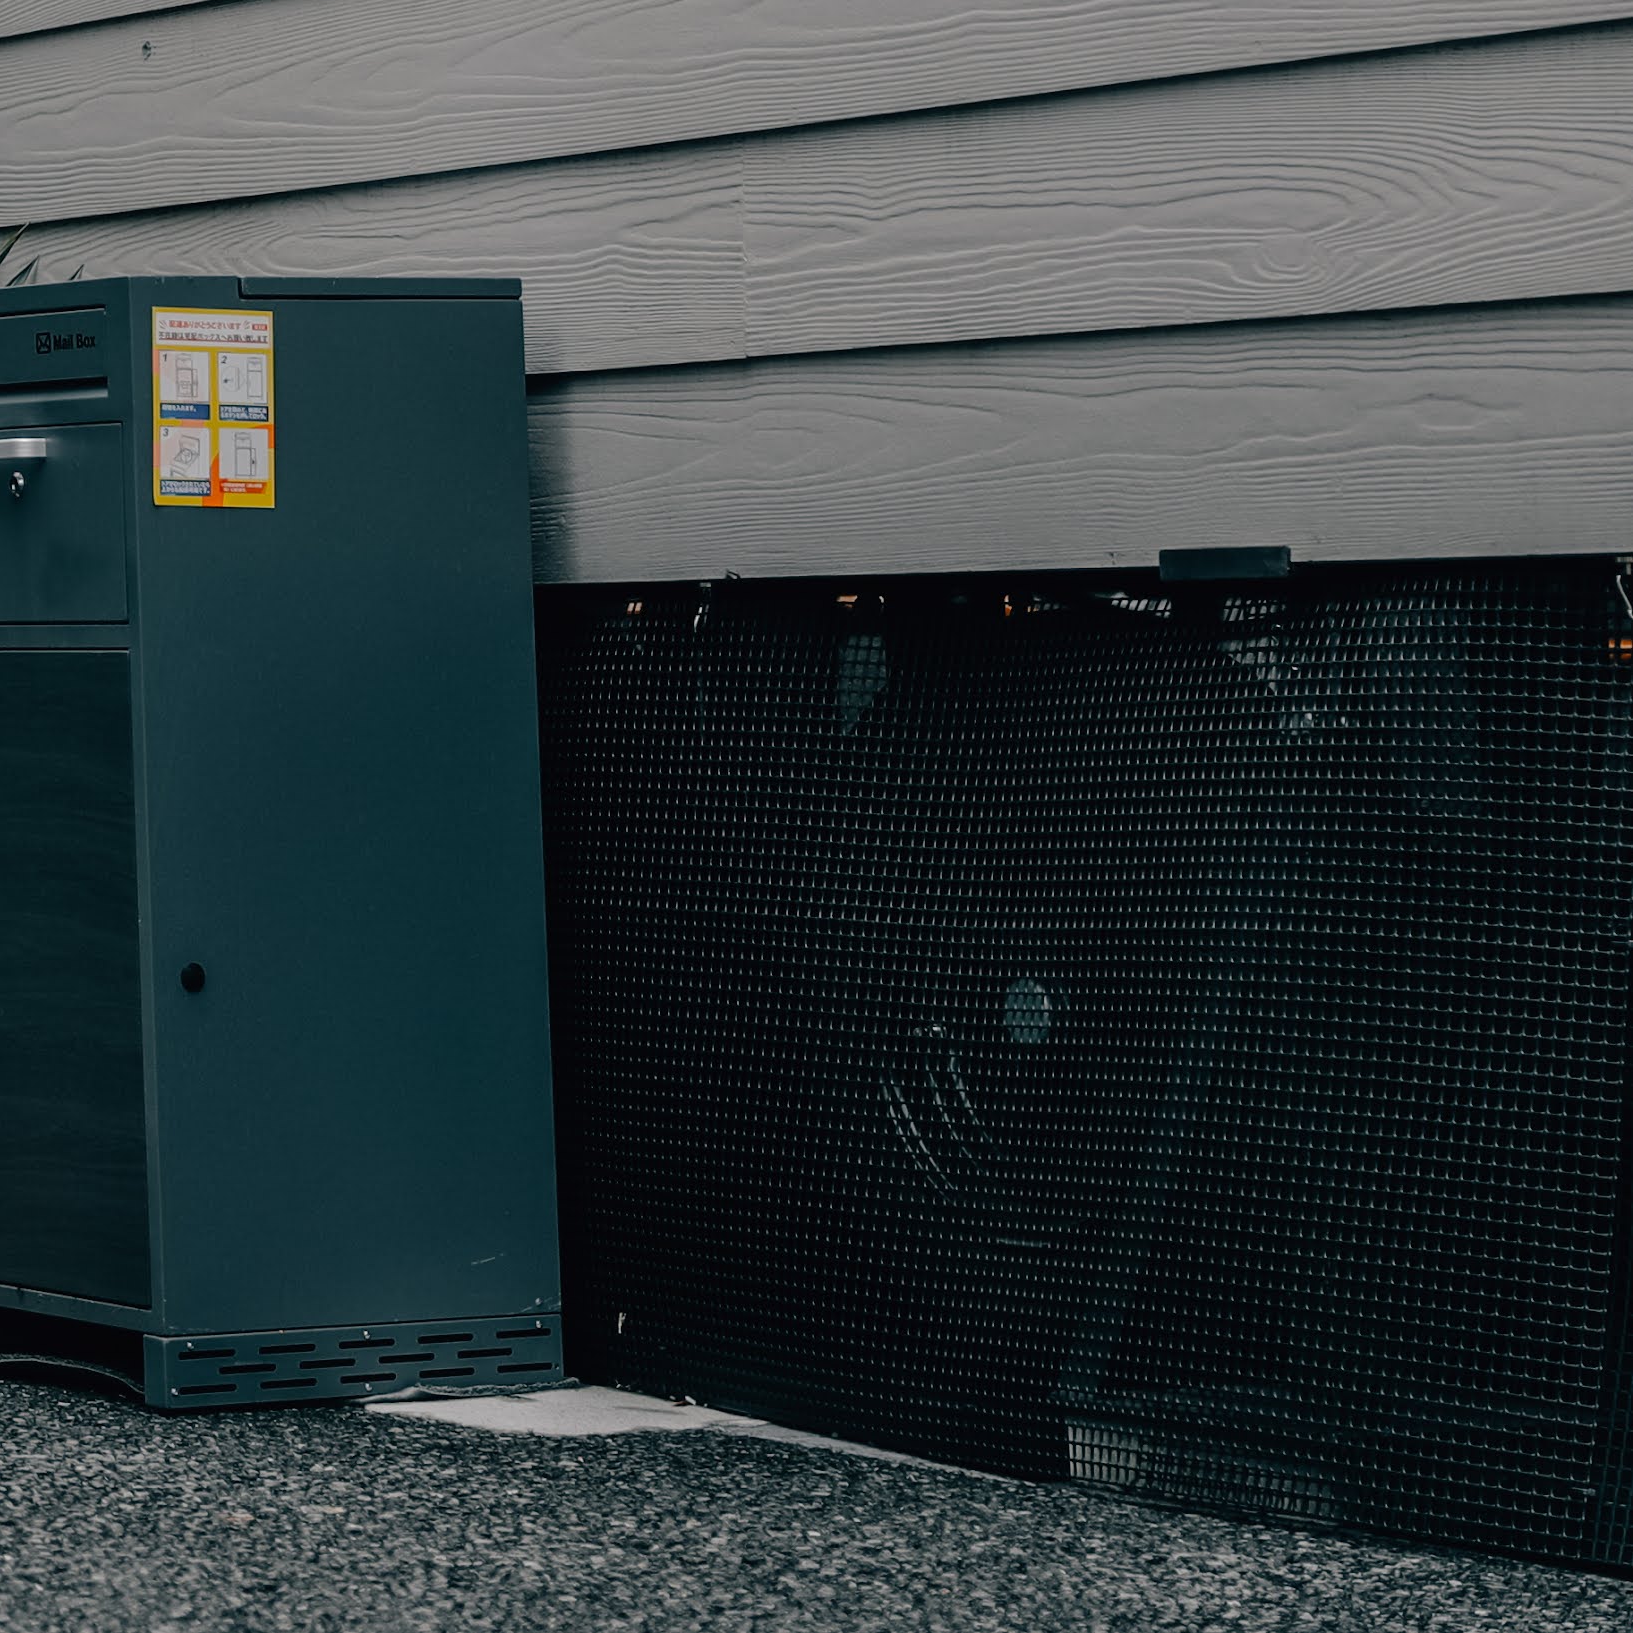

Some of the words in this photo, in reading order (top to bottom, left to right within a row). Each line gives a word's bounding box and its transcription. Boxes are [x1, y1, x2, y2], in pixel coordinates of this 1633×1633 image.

[53, 334, 74, 350] Mail
[76, 333, 96, 349] Box
[220, 355, 228, 364] 2
[162, 428, 169, 437] 3
